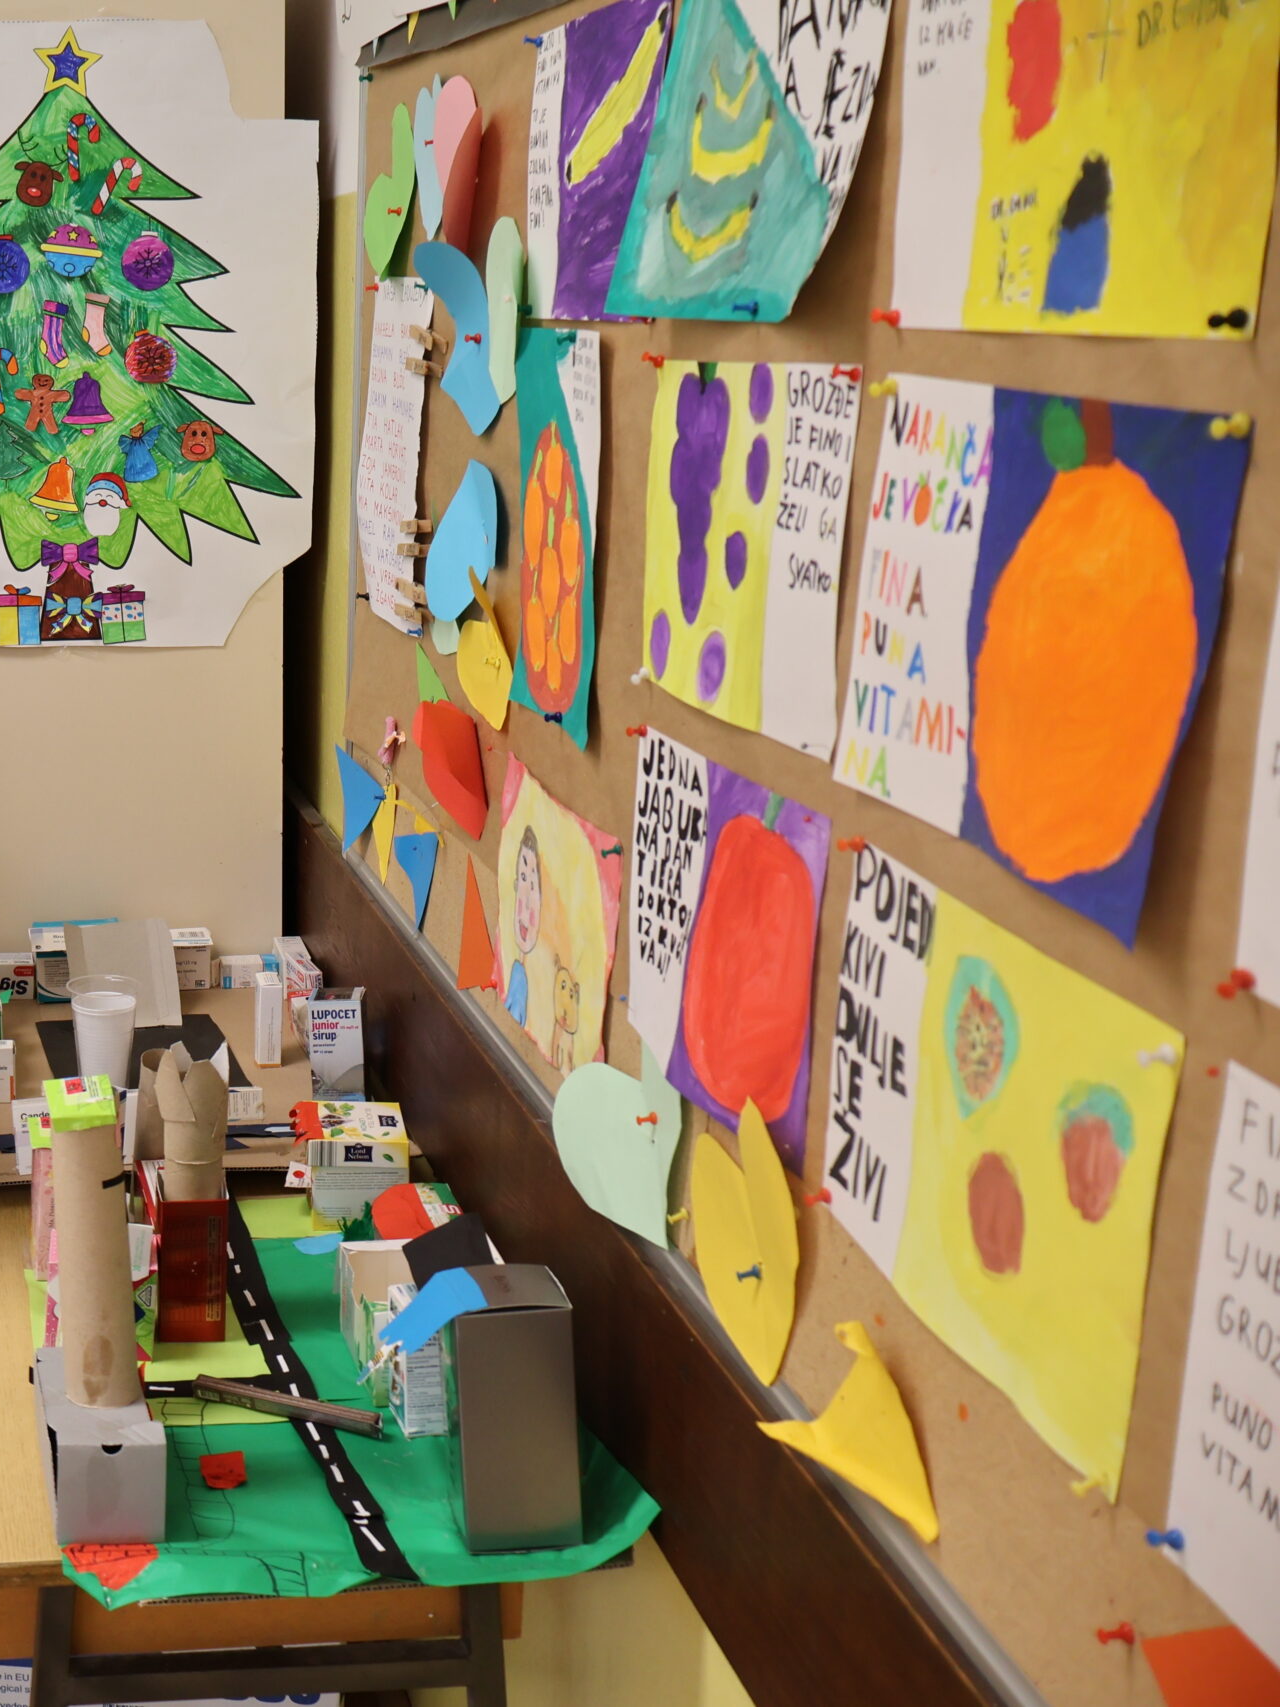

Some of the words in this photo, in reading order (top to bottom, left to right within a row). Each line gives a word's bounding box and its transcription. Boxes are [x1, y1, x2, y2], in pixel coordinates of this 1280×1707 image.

[787, 417, 803, 446] JE
[809, 424, 843, 458] FINO
[783, 456, 843, 500] SLATKO
[872, 471, 897, 521] JE
[819, 507, 838, 544] GA
[860, 611, 927, 685] PUNA
[854, 678, 966, 756] VITAMI-
[643, 738, 704, 797] JEDNA
[637, 821, 659, 858] NA
[841, 920, 887, 998] KIVI
[311, 1009, 357, 1020] LUPOCET
[311, 1021, 339, 1032] junior
[313, 1031, 337, 1042] sirup
[834, 984, 907, 1098] DULJE
[1211, 1380, 1274, 1453] PUNO
[4, 1672, 13, 1680] in
[15, 1673, 30, 1682] EU
